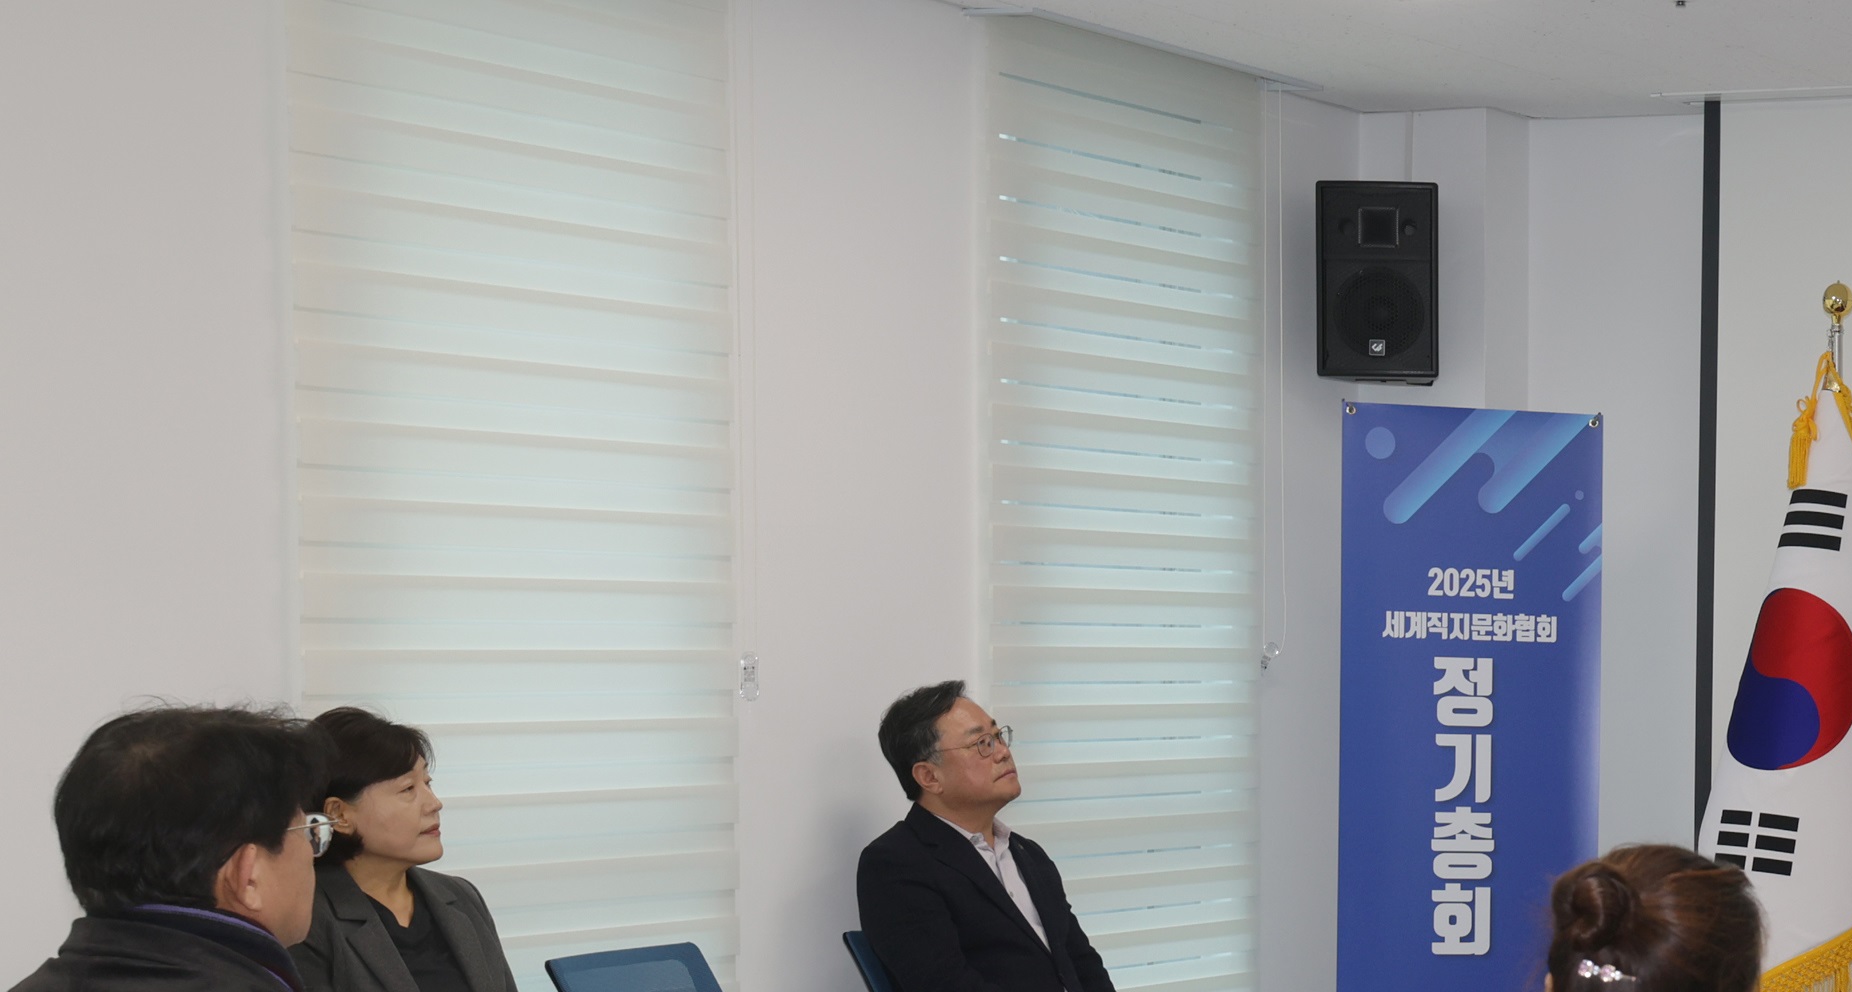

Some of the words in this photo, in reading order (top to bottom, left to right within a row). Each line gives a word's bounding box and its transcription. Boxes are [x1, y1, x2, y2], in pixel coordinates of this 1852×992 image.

[1427, 567, 1515, 599] 2025년
[1382, 610, 1557, 643] 세계직지문화협회
[1431, 656, 1494, 955] 정기총회
